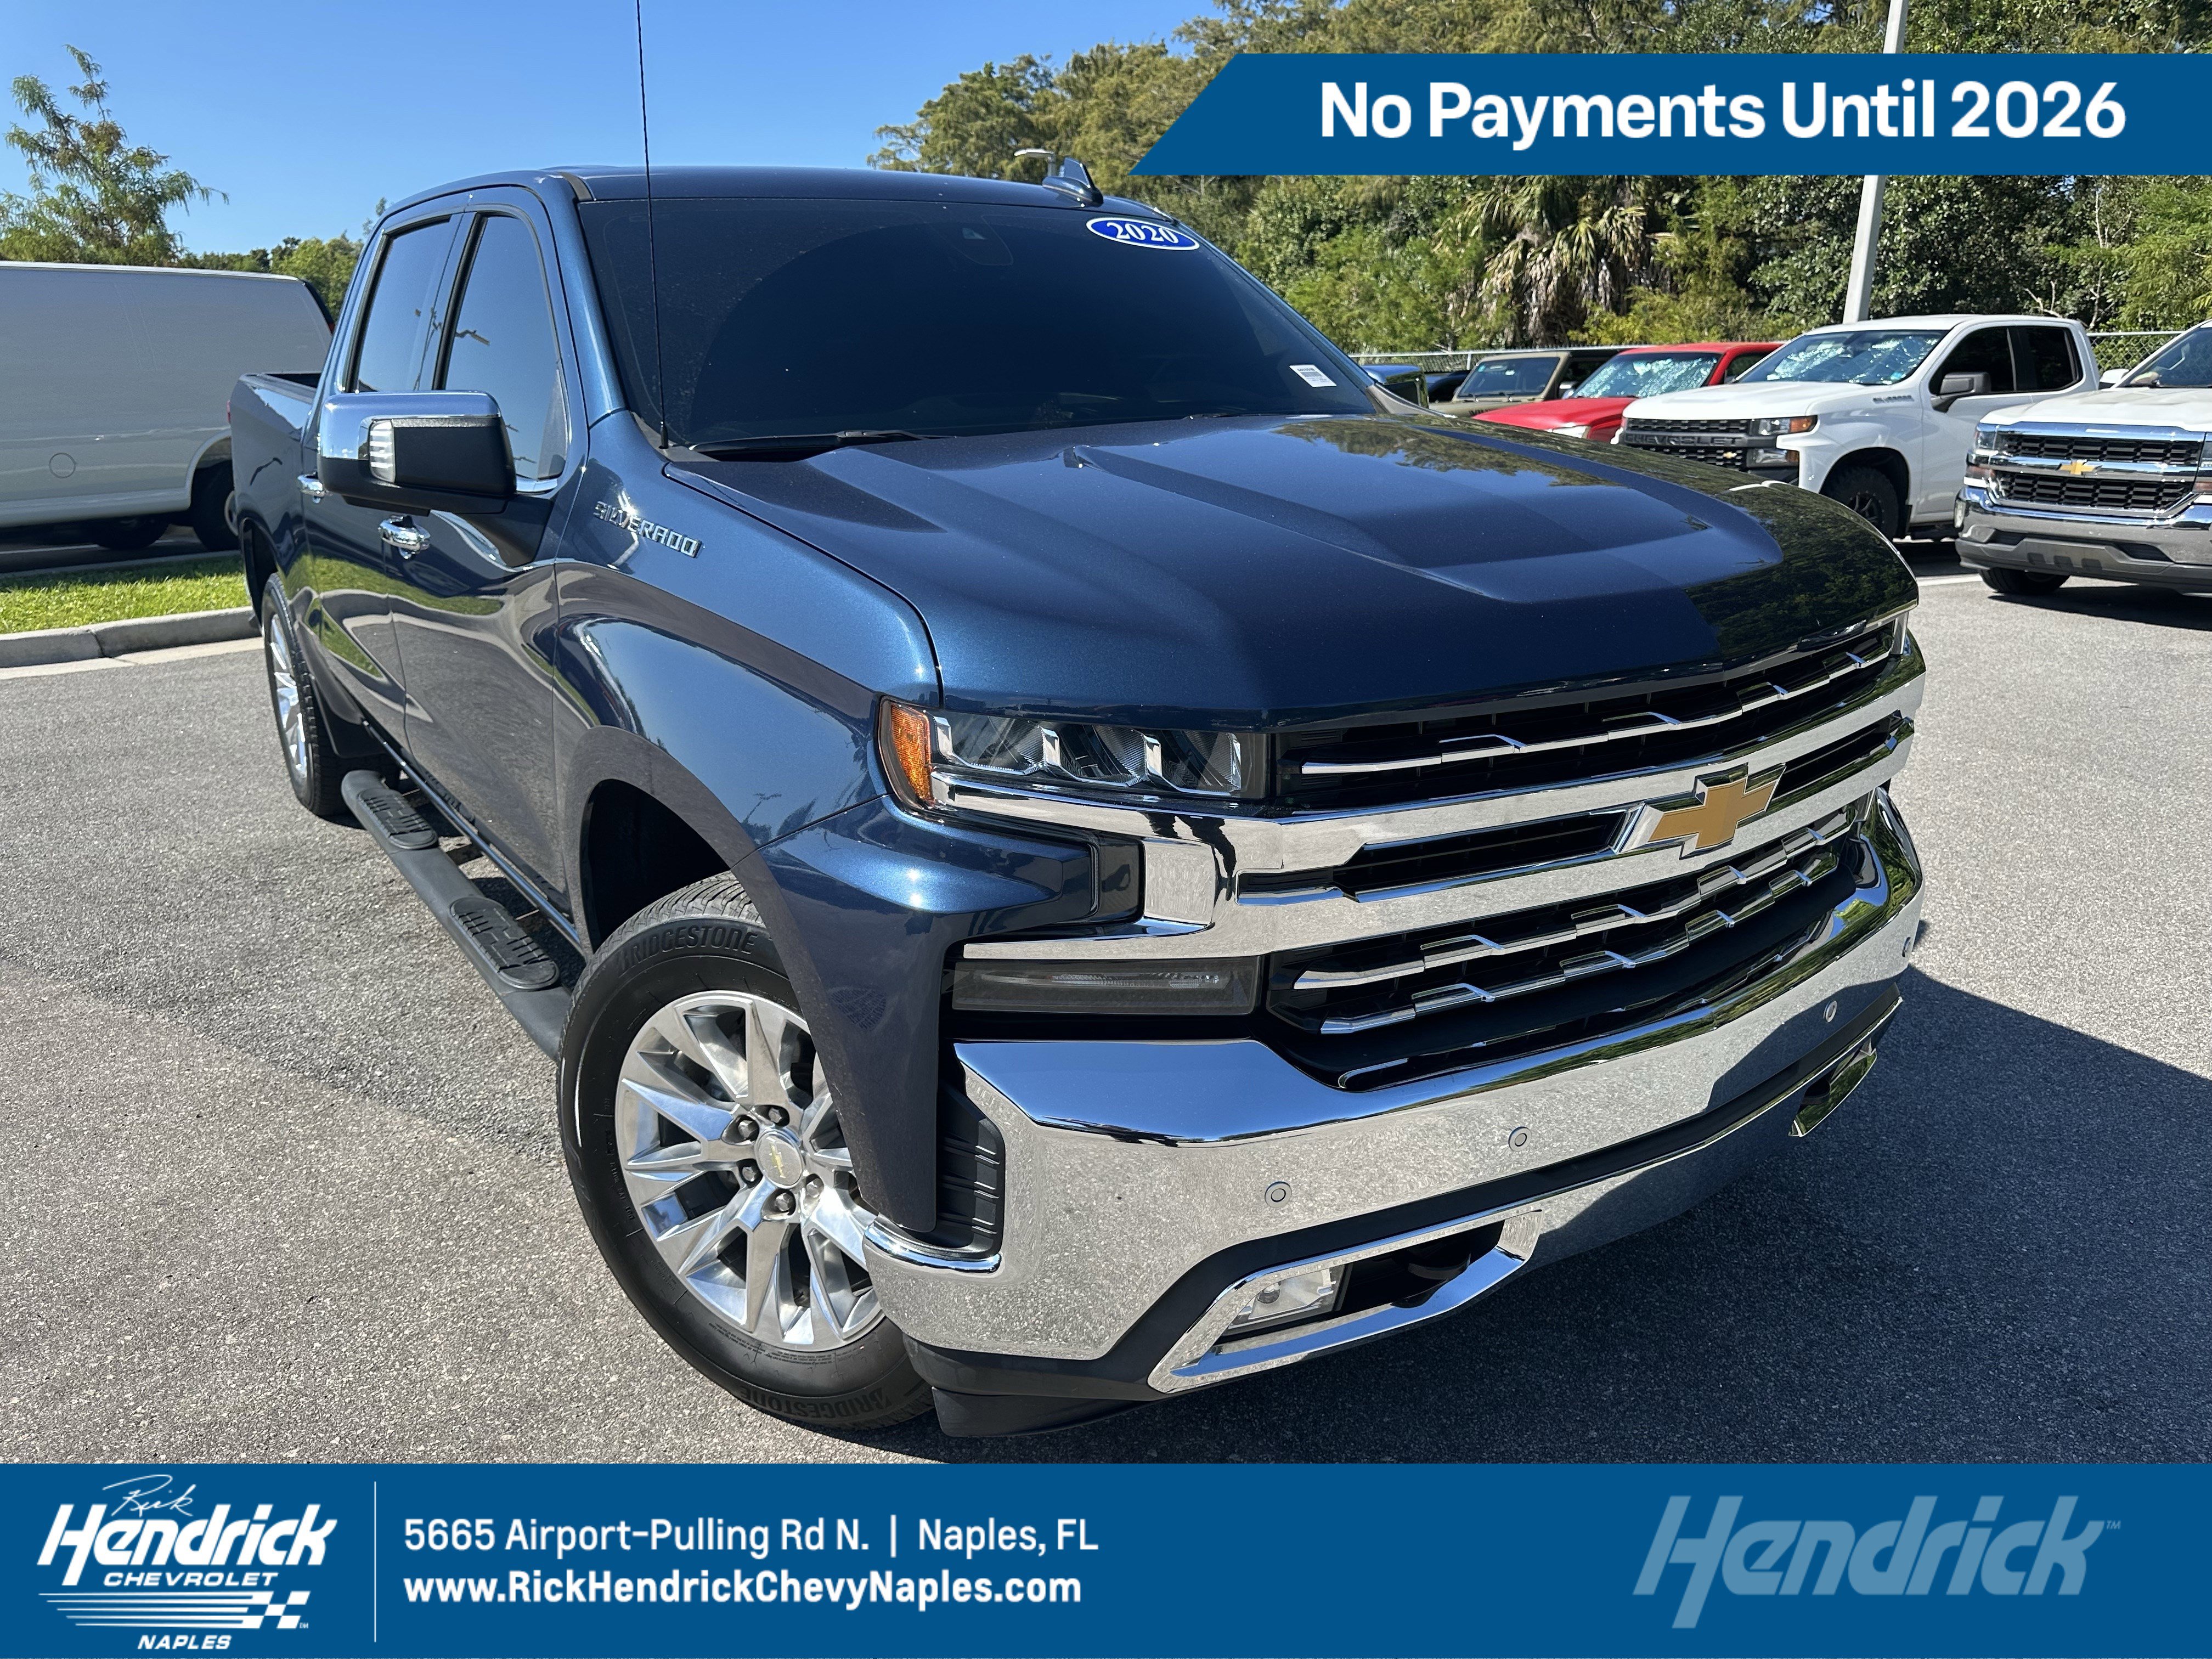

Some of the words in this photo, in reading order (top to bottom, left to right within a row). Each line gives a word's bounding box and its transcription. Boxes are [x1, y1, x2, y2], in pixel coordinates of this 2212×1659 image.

[1107, 222, 1178, 244] 2020
[593, 501, 703, 558] SILVERADO
[737, 1386, 893, 1420] BRIDGESTONE
